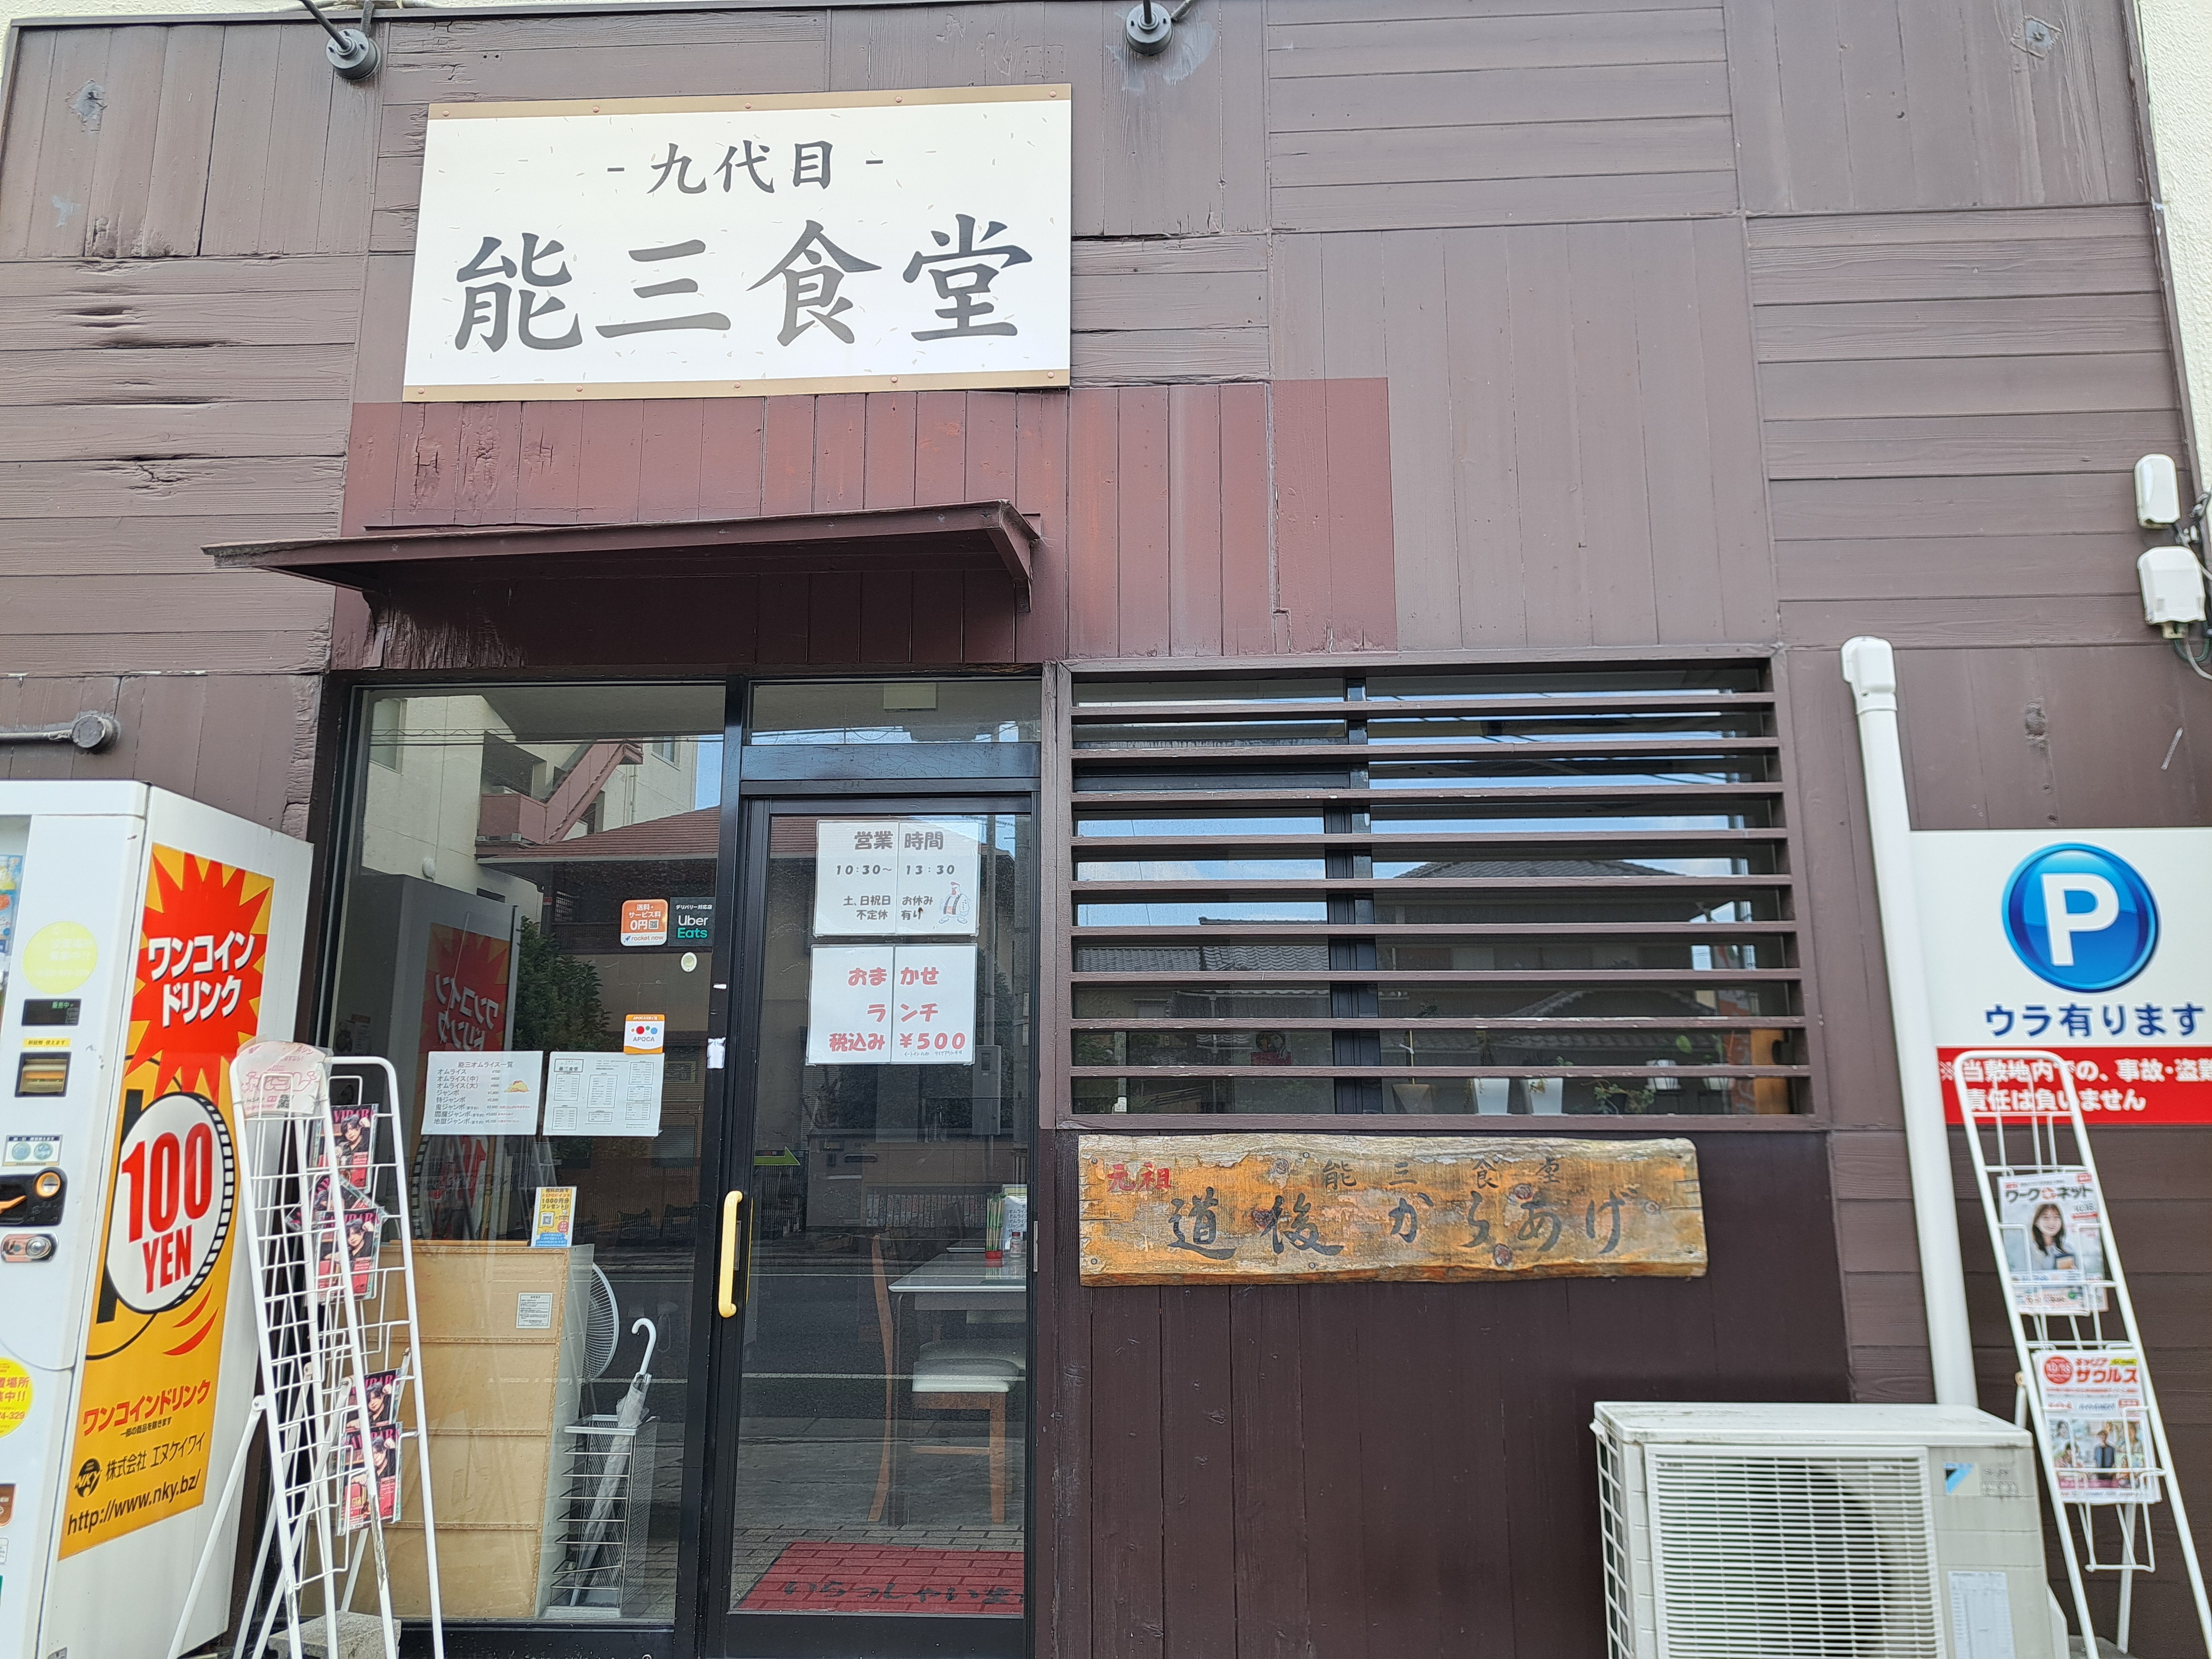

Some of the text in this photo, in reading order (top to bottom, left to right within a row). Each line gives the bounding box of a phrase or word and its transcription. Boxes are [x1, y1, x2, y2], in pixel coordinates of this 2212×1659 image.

[454, 212, 1033, 354] 能三食堂
[630, 919, 648, 930] 0円
[677, 928, 708, 939] Eats
[678, 915, 708, 926] Uber
[147, 929, 257, 982] ワンコイン
[161, 974, 243, 1028] ドリンク
[1984, 1002, 2204, 1038] ウラ有ります
[830, 1033, 885, 1051] 税込み
[121, 1121, 212, 1243] 100
[1106, 1162, 1172, 1192] 元祖
[1167, 1186, 1639, 1261] 道後からあげ
[142, 1225, 192, 1294] YEN
[83, 1379, 211, 1436] ワンコインドリンク
[120, 1416, 172, 1438] 一部の商品を除きます
[106, 1431, 206, 1482] 株式会社 エヌケイワイ
[67, 1468, 201, 1536] http://www.nky.bz/
[784, 1581, 1024, 1604] いらっしゃいま
